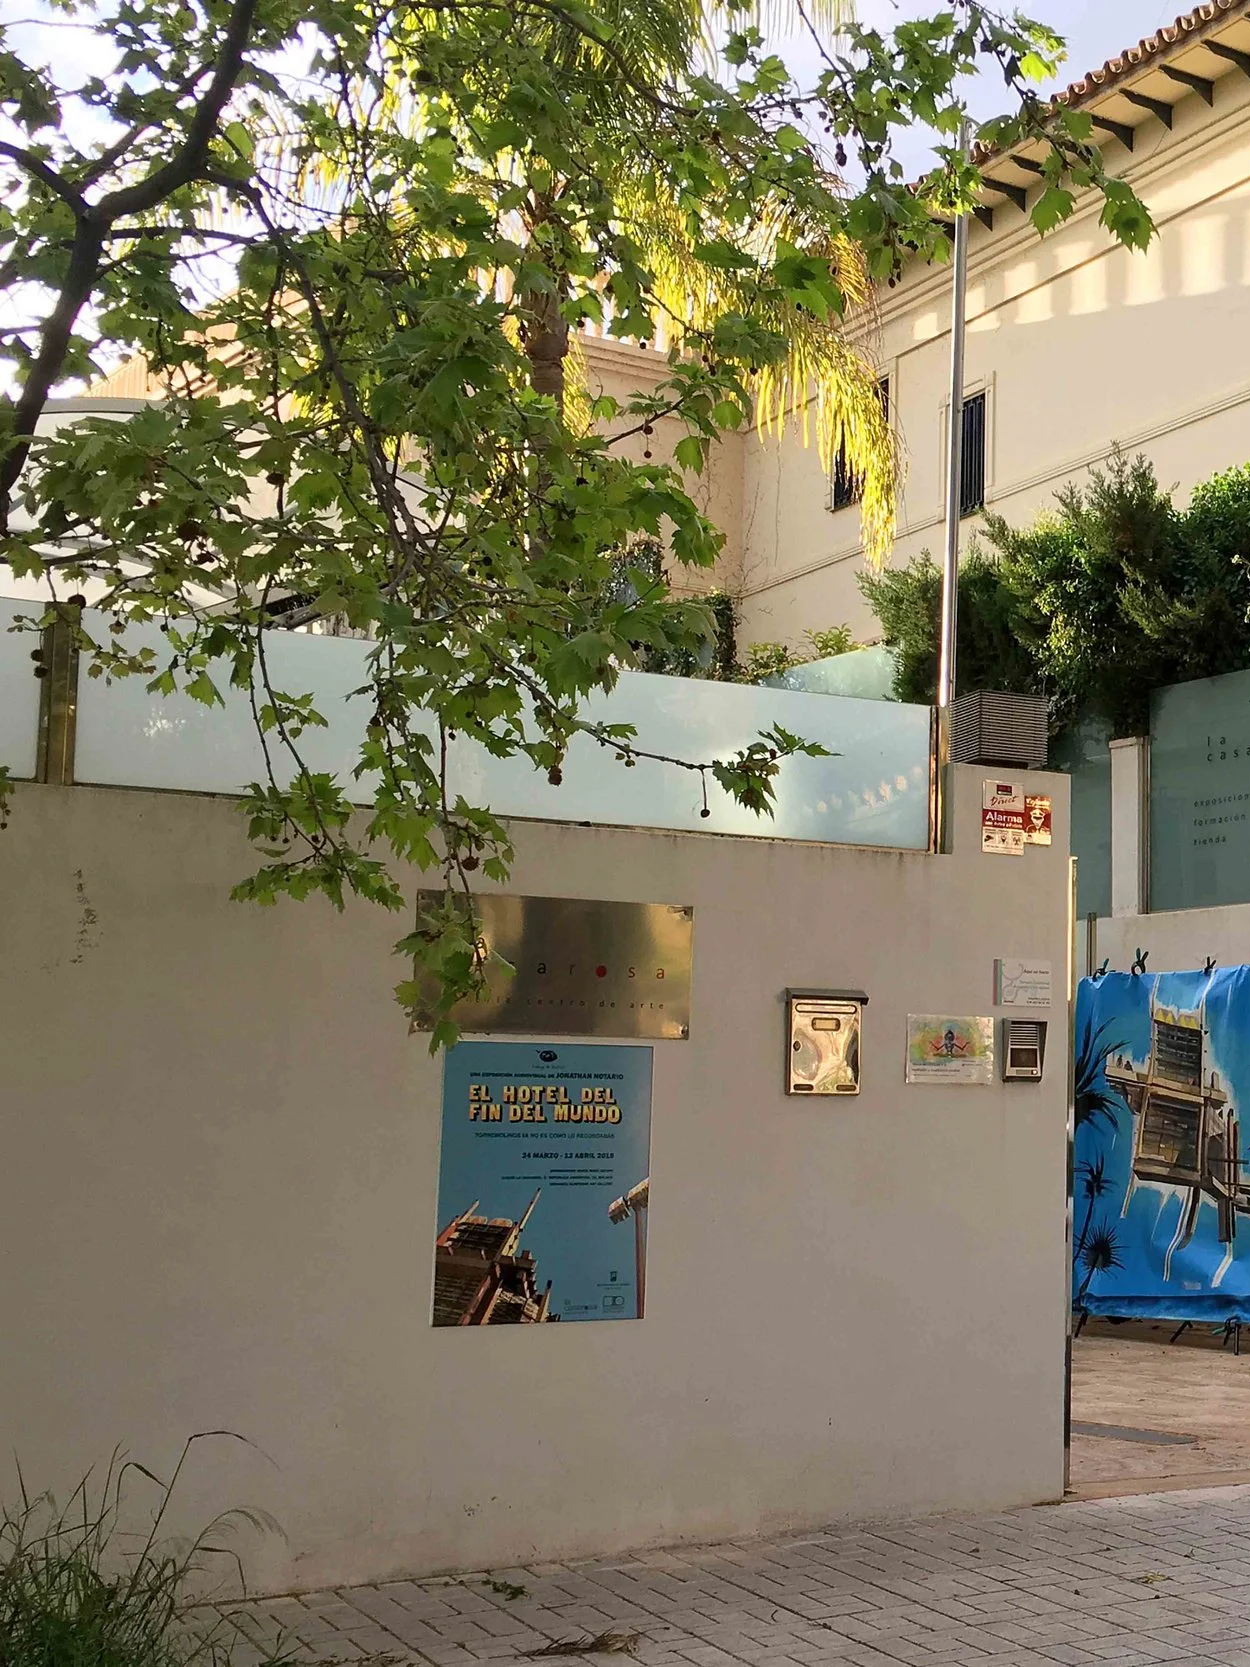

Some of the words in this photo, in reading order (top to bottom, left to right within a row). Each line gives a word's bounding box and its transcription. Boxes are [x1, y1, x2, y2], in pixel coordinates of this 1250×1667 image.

[985, 811, 1023, 824] Alarma
[599, 1001, 616, 1009] de
[629, 1001, 665, 1010] arte
[469, 1084, 492, 1102] EL
[503, 1085, 571, 1104] HOTEL
[582, 1087, 617, 1105] DEL
[469, 1103, 502, 1122] FIN
[509, 1104, 547, 1123] DEL
[554, 1104, 623, 1125] MUNDO
[532, 1152, 559, 1160] MARZO
